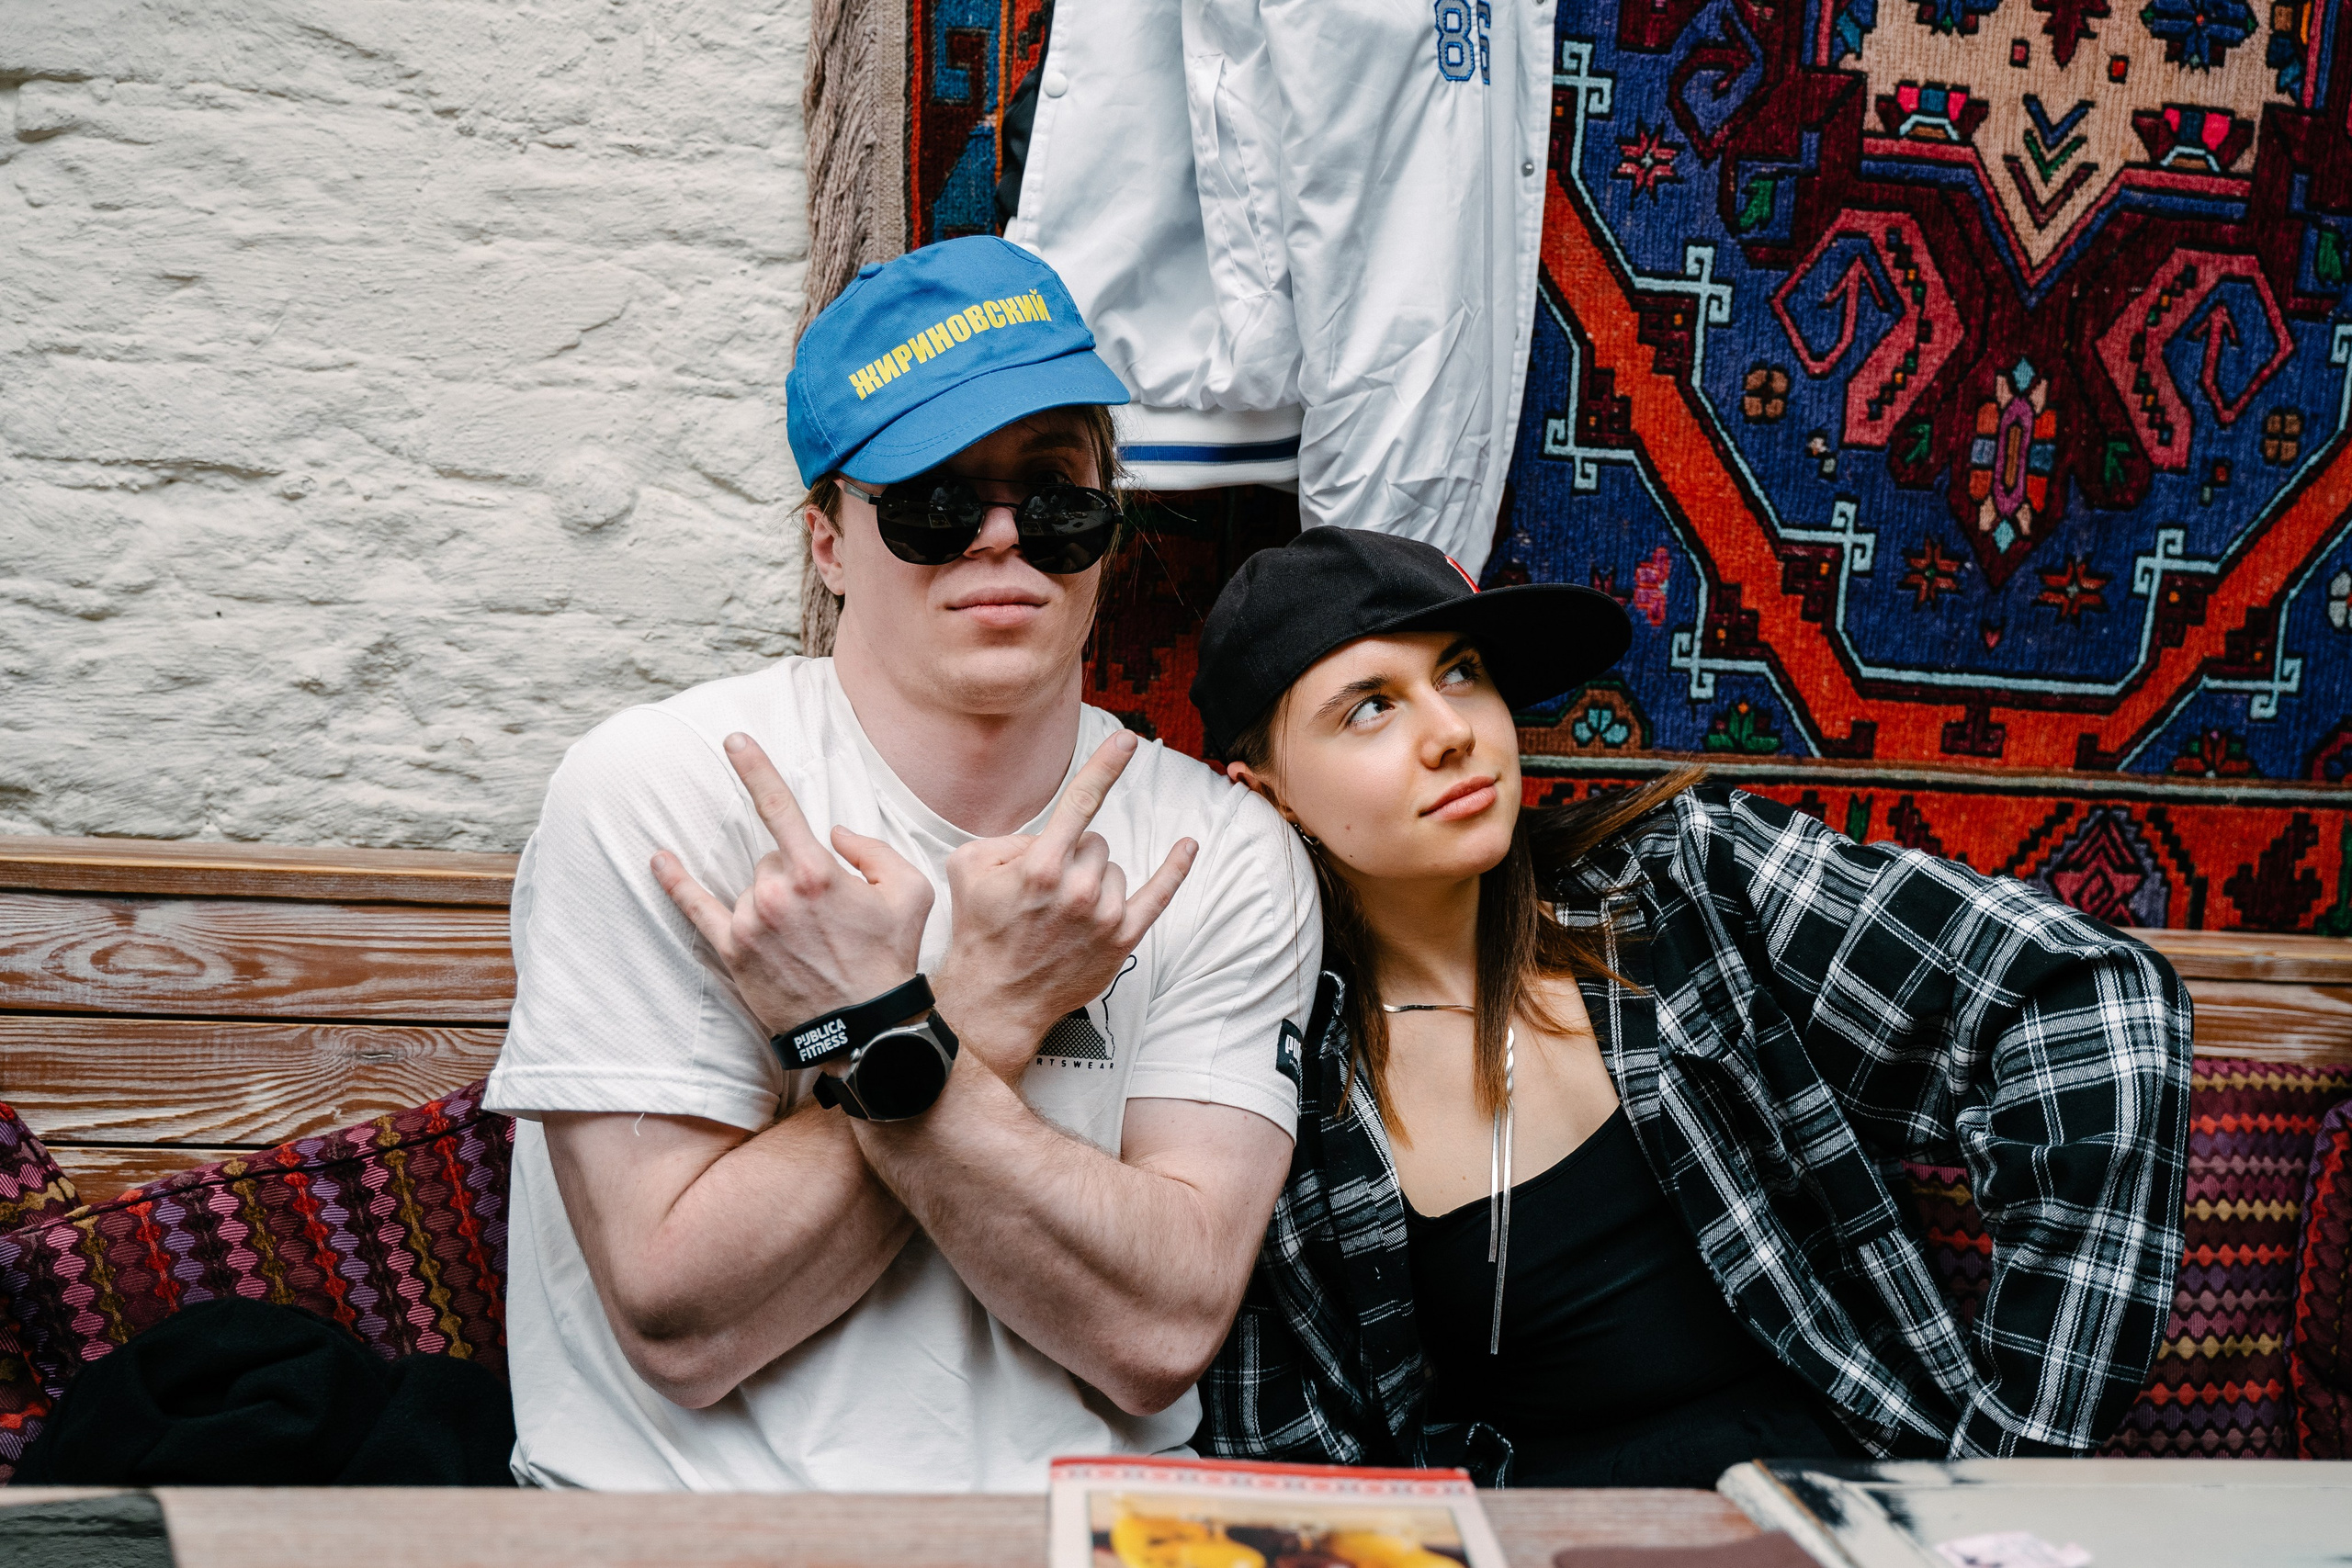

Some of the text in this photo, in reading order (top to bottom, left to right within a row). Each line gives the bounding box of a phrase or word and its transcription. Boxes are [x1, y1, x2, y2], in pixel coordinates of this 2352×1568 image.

[848, 288, 1052, 400] ЖИРИНОВСКИЙ
[794, 1018, 846, 1050] PUBLICA
[1036, 1057, 1114, 1070] RTSWEAR
